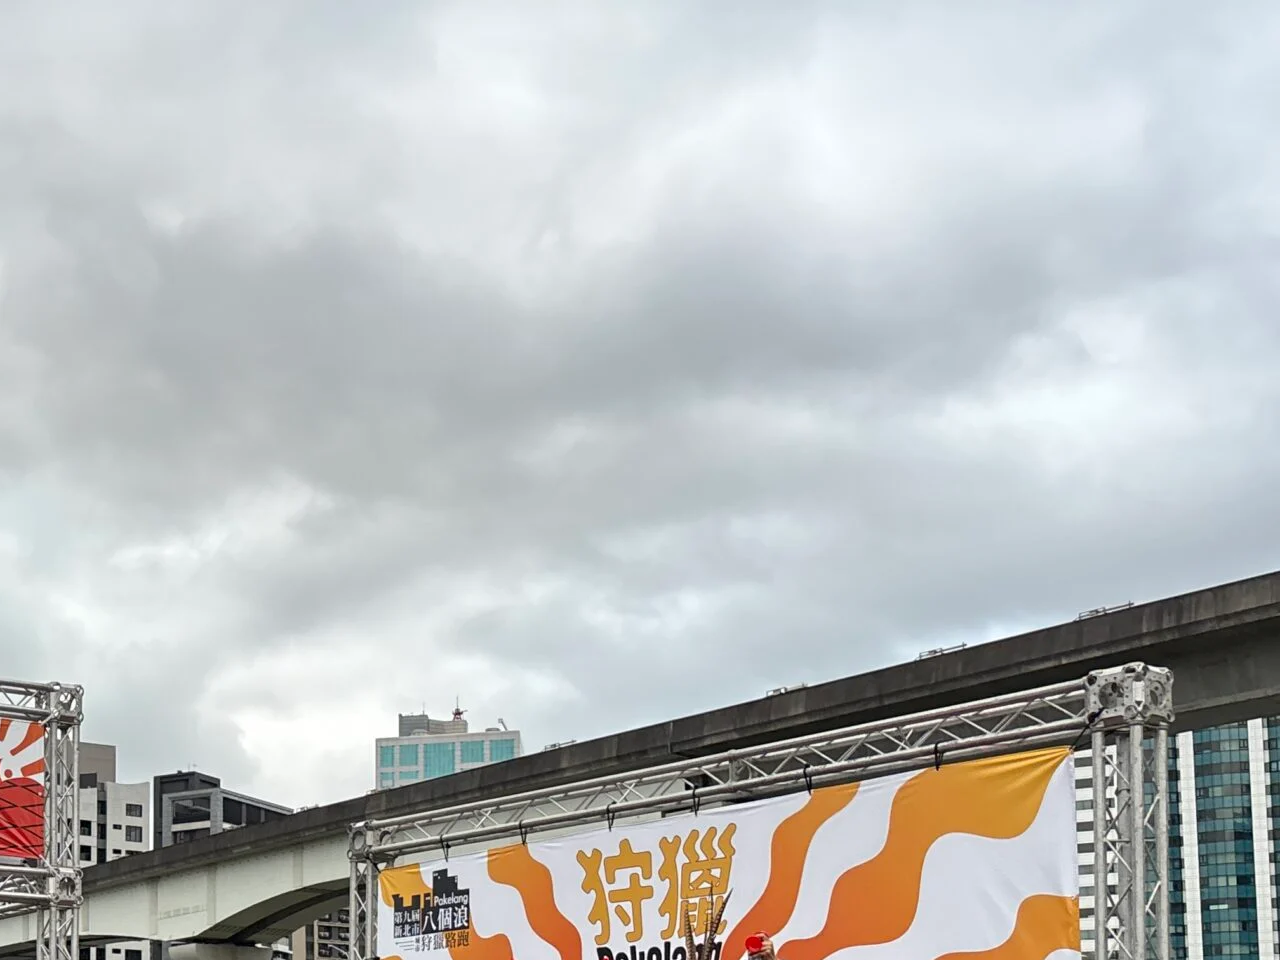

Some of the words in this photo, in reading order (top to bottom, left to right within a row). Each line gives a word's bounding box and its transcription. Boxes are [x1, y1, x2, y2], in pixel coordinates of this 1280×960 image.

[576, 823, 737, 945] 狩獵
[434, 892, 469, 907] Pakelang
[422, 905, 469, 931] 八個浪
